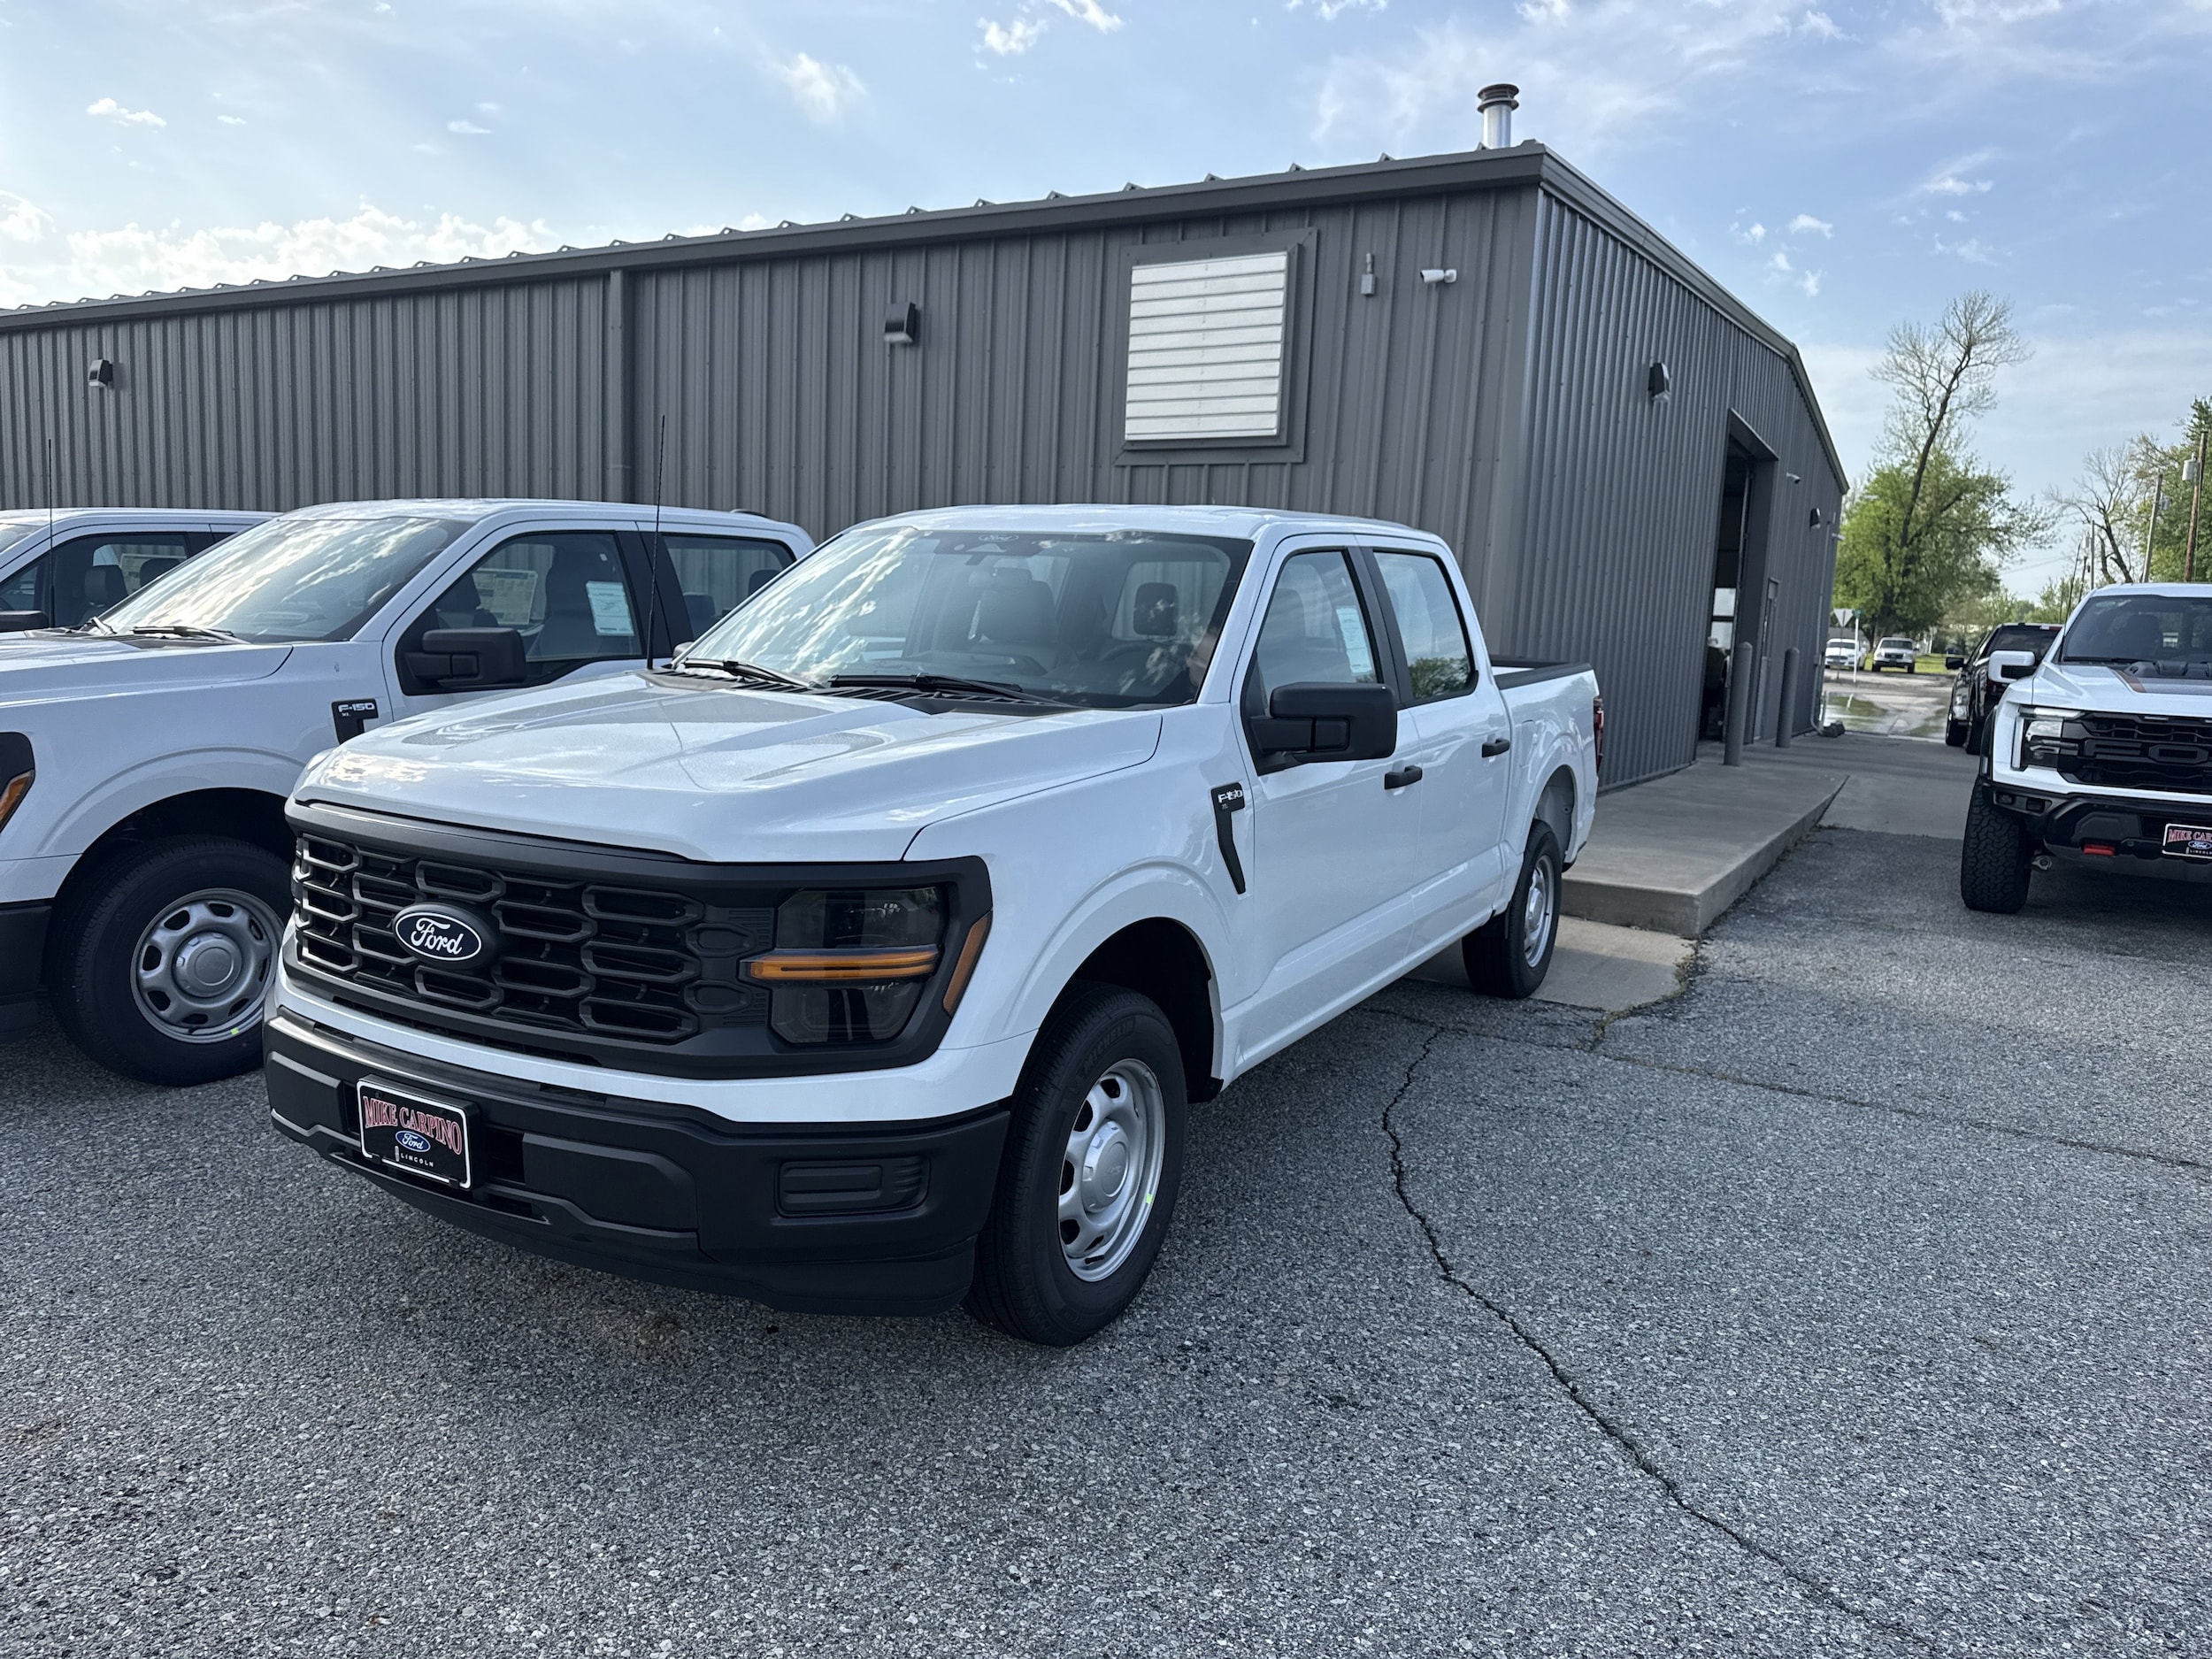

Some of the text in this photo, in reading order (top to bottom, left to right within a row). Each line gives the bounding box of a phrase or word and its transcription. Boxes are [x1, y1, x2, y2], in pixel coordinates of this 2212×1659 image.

[338, 703, 375, 712] F-150
[1217, 789, 1243, 803] F-150
[2167, 829, 2193, 842] MIKE
[411, 918, 464, 955] Ford
[363, 1095, 463, 1155] MIKE CARPINO
[402, 1133, 424, 1150] Ford
[400, 1153, 434, 1167] LINCOLN
